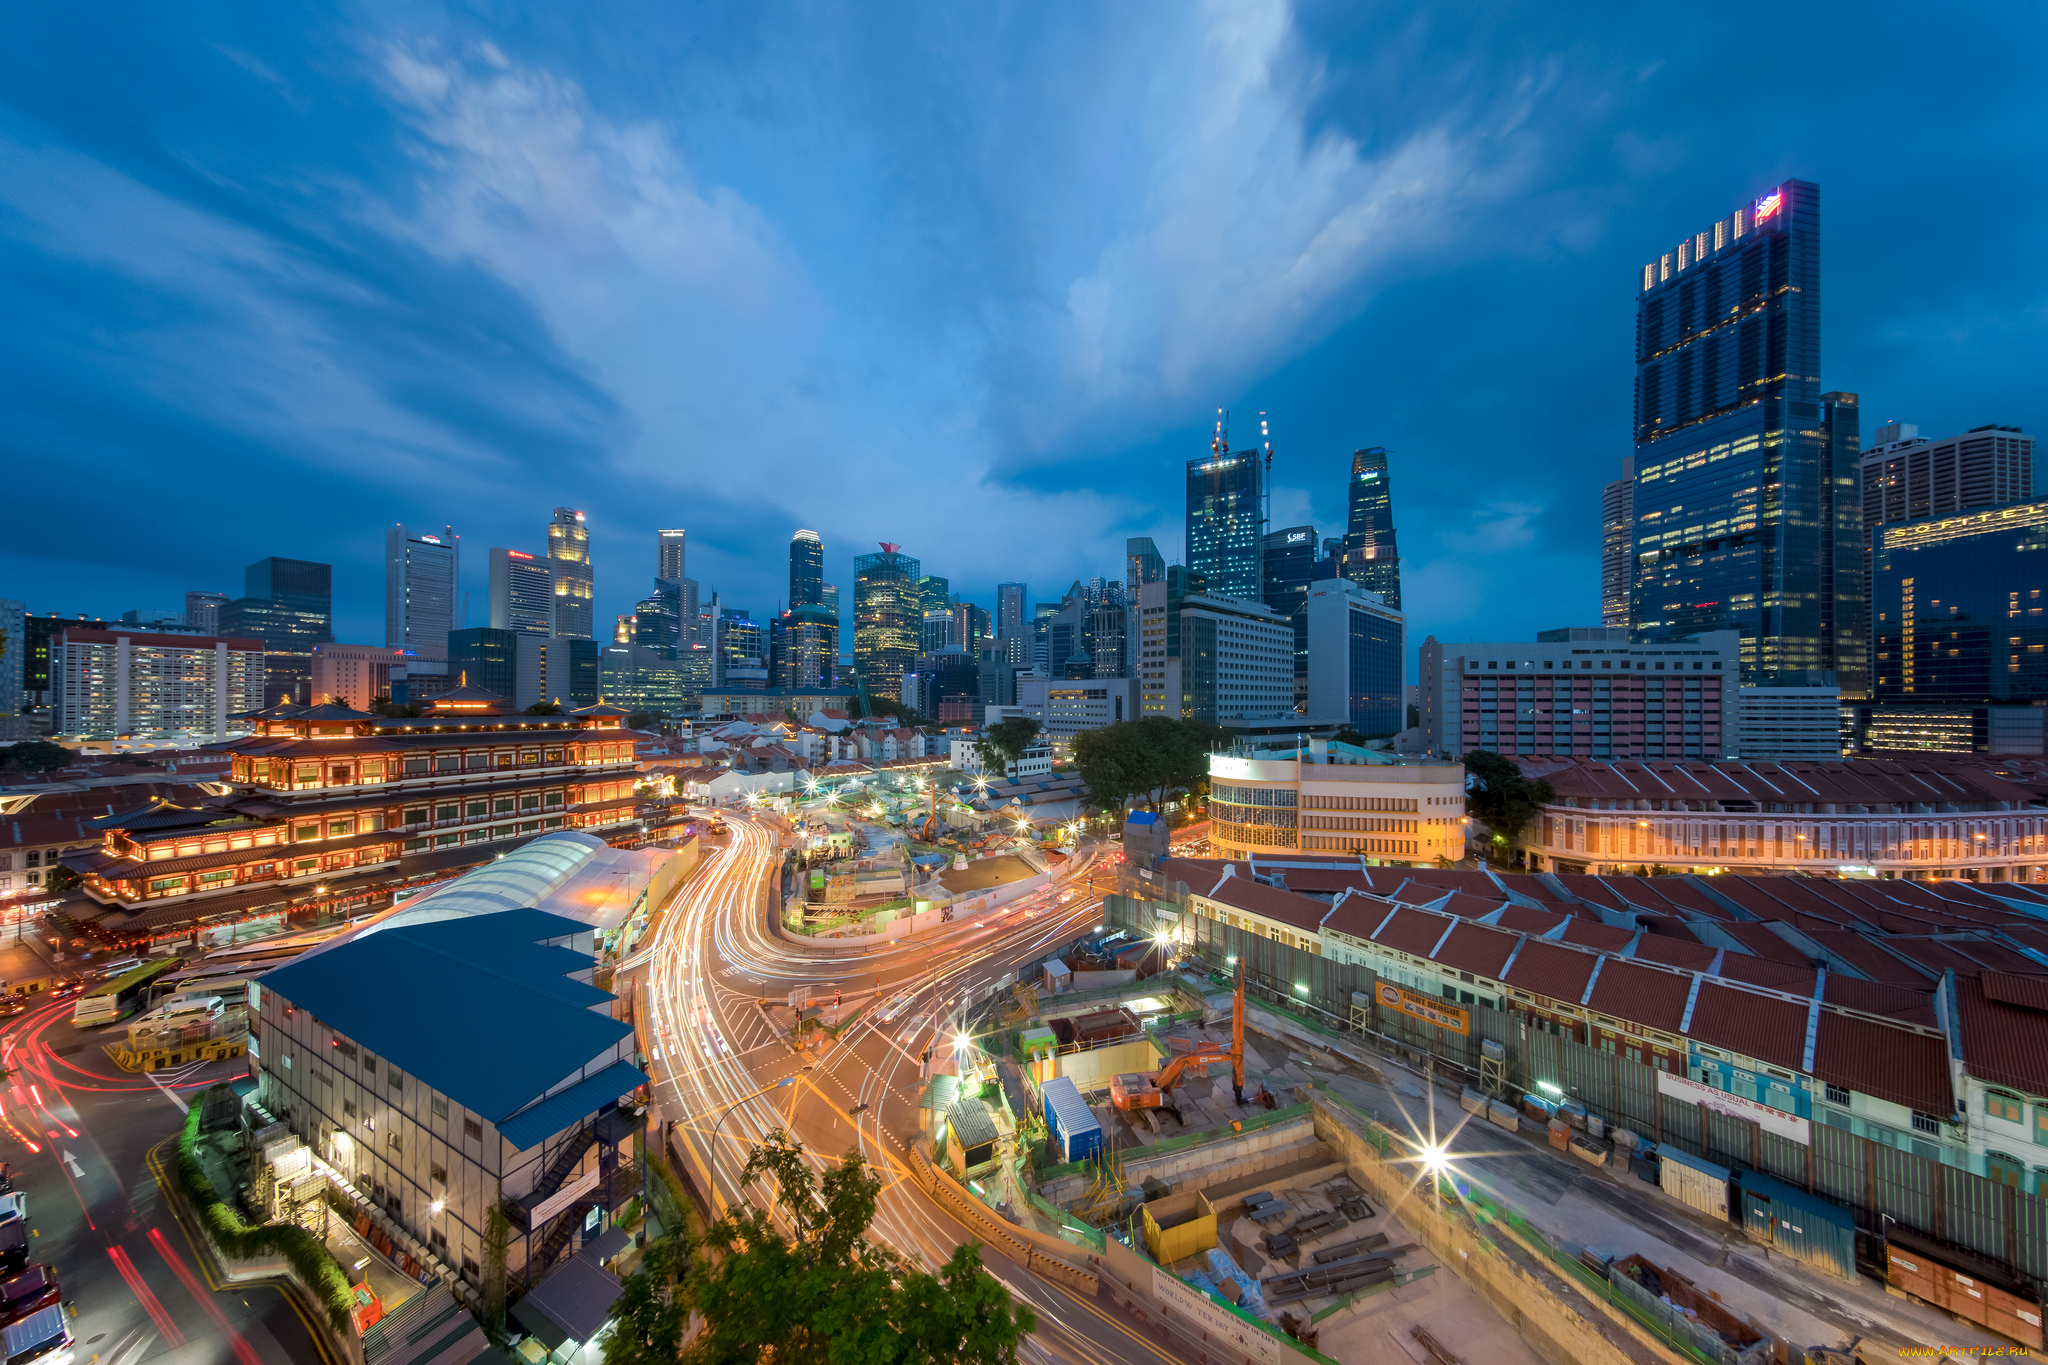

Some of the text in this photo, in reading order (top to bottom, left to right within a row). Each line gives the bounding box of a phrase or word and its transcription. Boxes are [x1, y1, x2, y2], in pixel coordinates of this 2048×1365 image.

[1894, 506, 2043, 537] SOFITEL
[1403, 992, 1460, 1017] FIGHT DENGUE
[1665, 1073, 1706, 1092] BUSINESS
[1707, 1087, 1719, 1096] AS
[1720, 1091, 1750, 1106] USUAL
[1155, 1269, 1175, 1286] WATER
[1175, 1281, 1220, 1313] CONSERVATION
[1221, 1310, 1229, 1319] AS
[1235, 1319, 1250, 1330] WAY
[1250, 1327, 1260, 1336] OF
[1261, 1333, 1276, 1345] LIFE
[1158, 1283, 1229, 1333] WORLD WTER DAY
